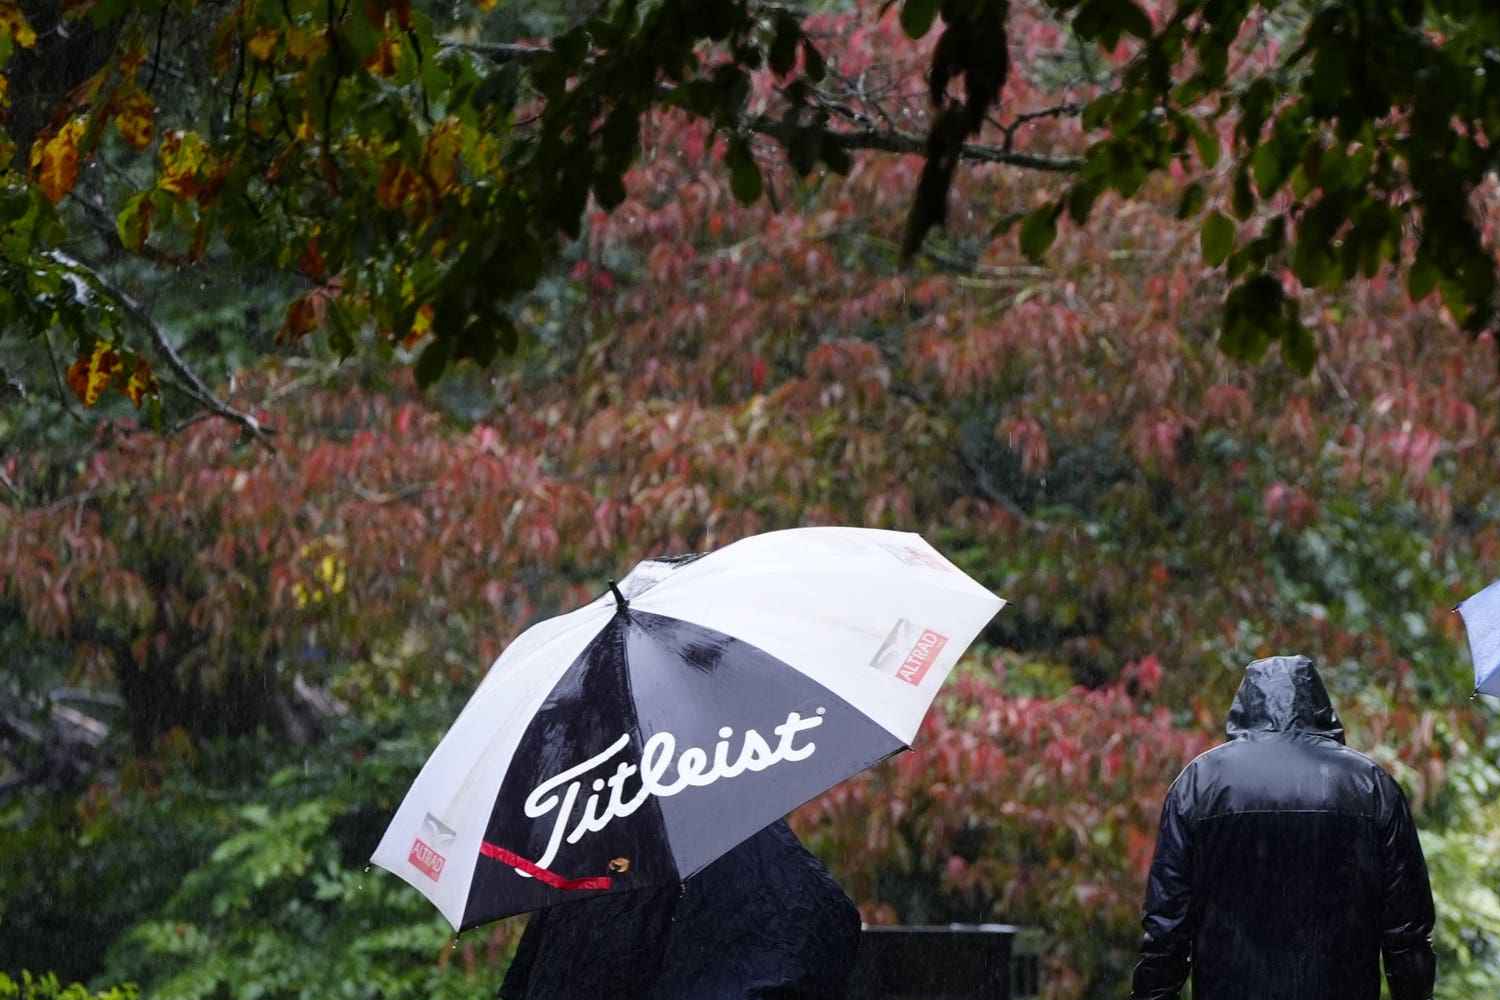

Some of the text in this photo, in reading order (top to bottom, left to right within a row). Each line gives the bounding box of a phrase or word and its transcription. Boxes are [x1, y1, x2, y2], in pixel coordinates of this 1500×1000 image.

[899, 631, 939, 682] ALTRAD
[515, 711, 824, 877] Titleist
[411, 841, 443, 873] ALTRAD
